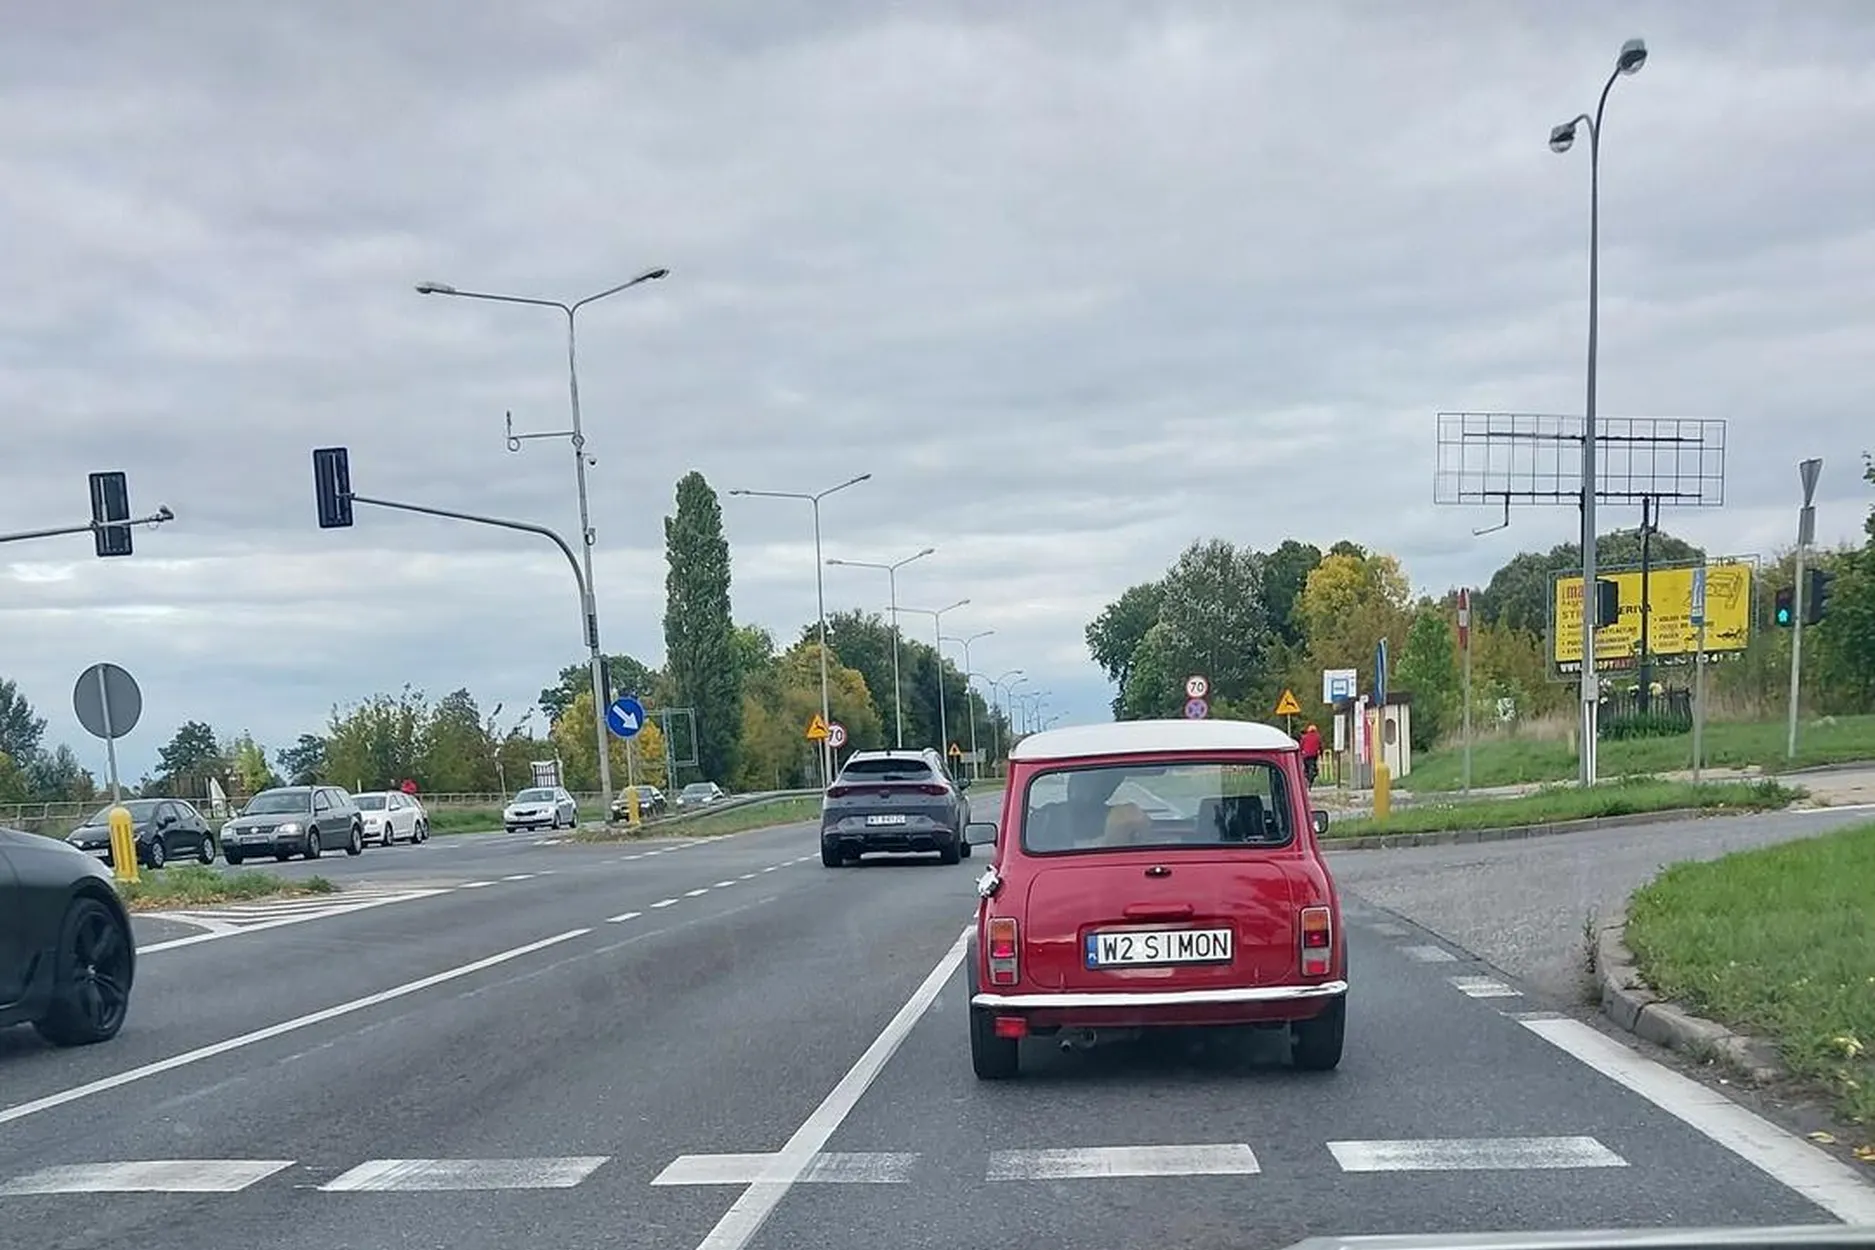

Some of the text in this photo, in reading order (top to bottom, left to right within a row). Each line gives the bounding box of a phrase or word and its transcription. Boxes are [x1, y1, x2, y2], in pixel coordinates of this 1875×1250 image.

[1190, 681, 1204, 693] 70
[828, 729, 843, 739] 70
[1103, 933, 1228, 961] W2 SIMON
